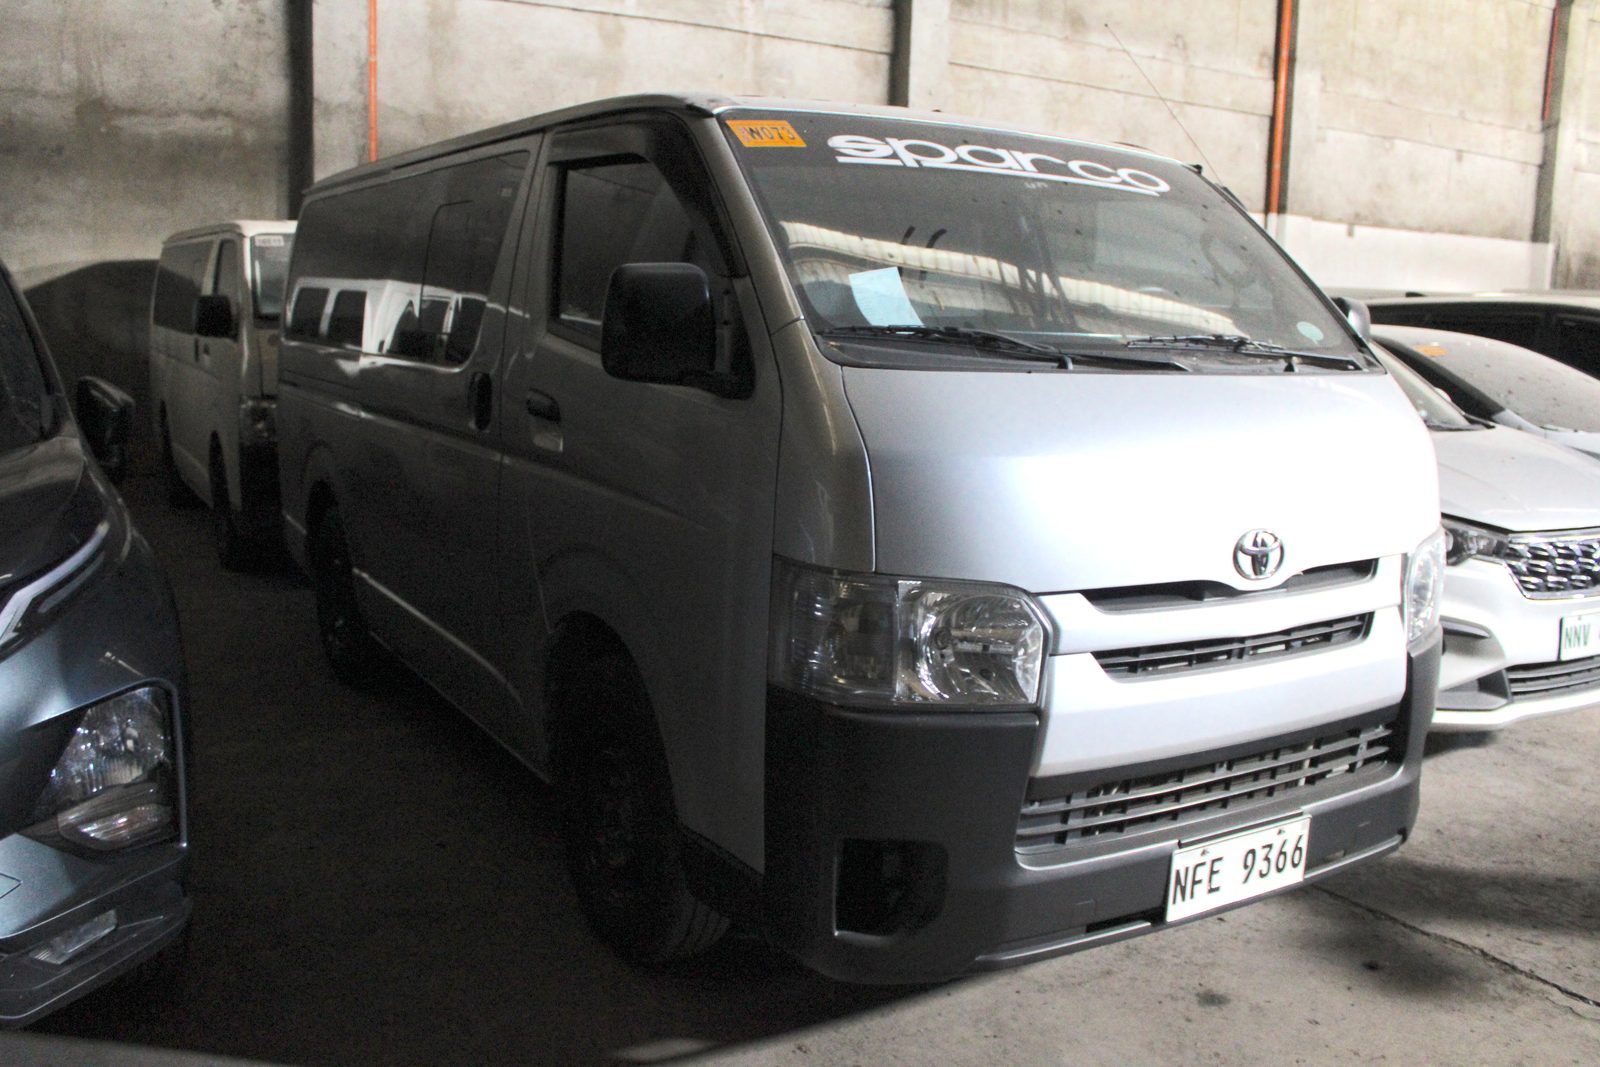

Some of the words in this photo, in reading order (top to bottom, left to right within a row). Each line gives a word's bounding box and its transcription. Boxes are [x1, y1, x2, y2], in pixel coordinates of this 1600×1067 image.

[1563, 623, 1592, 651] NNV
[1171, 856, 1224, 905] NFE
[1241, 833, 1304, 885] 9366
